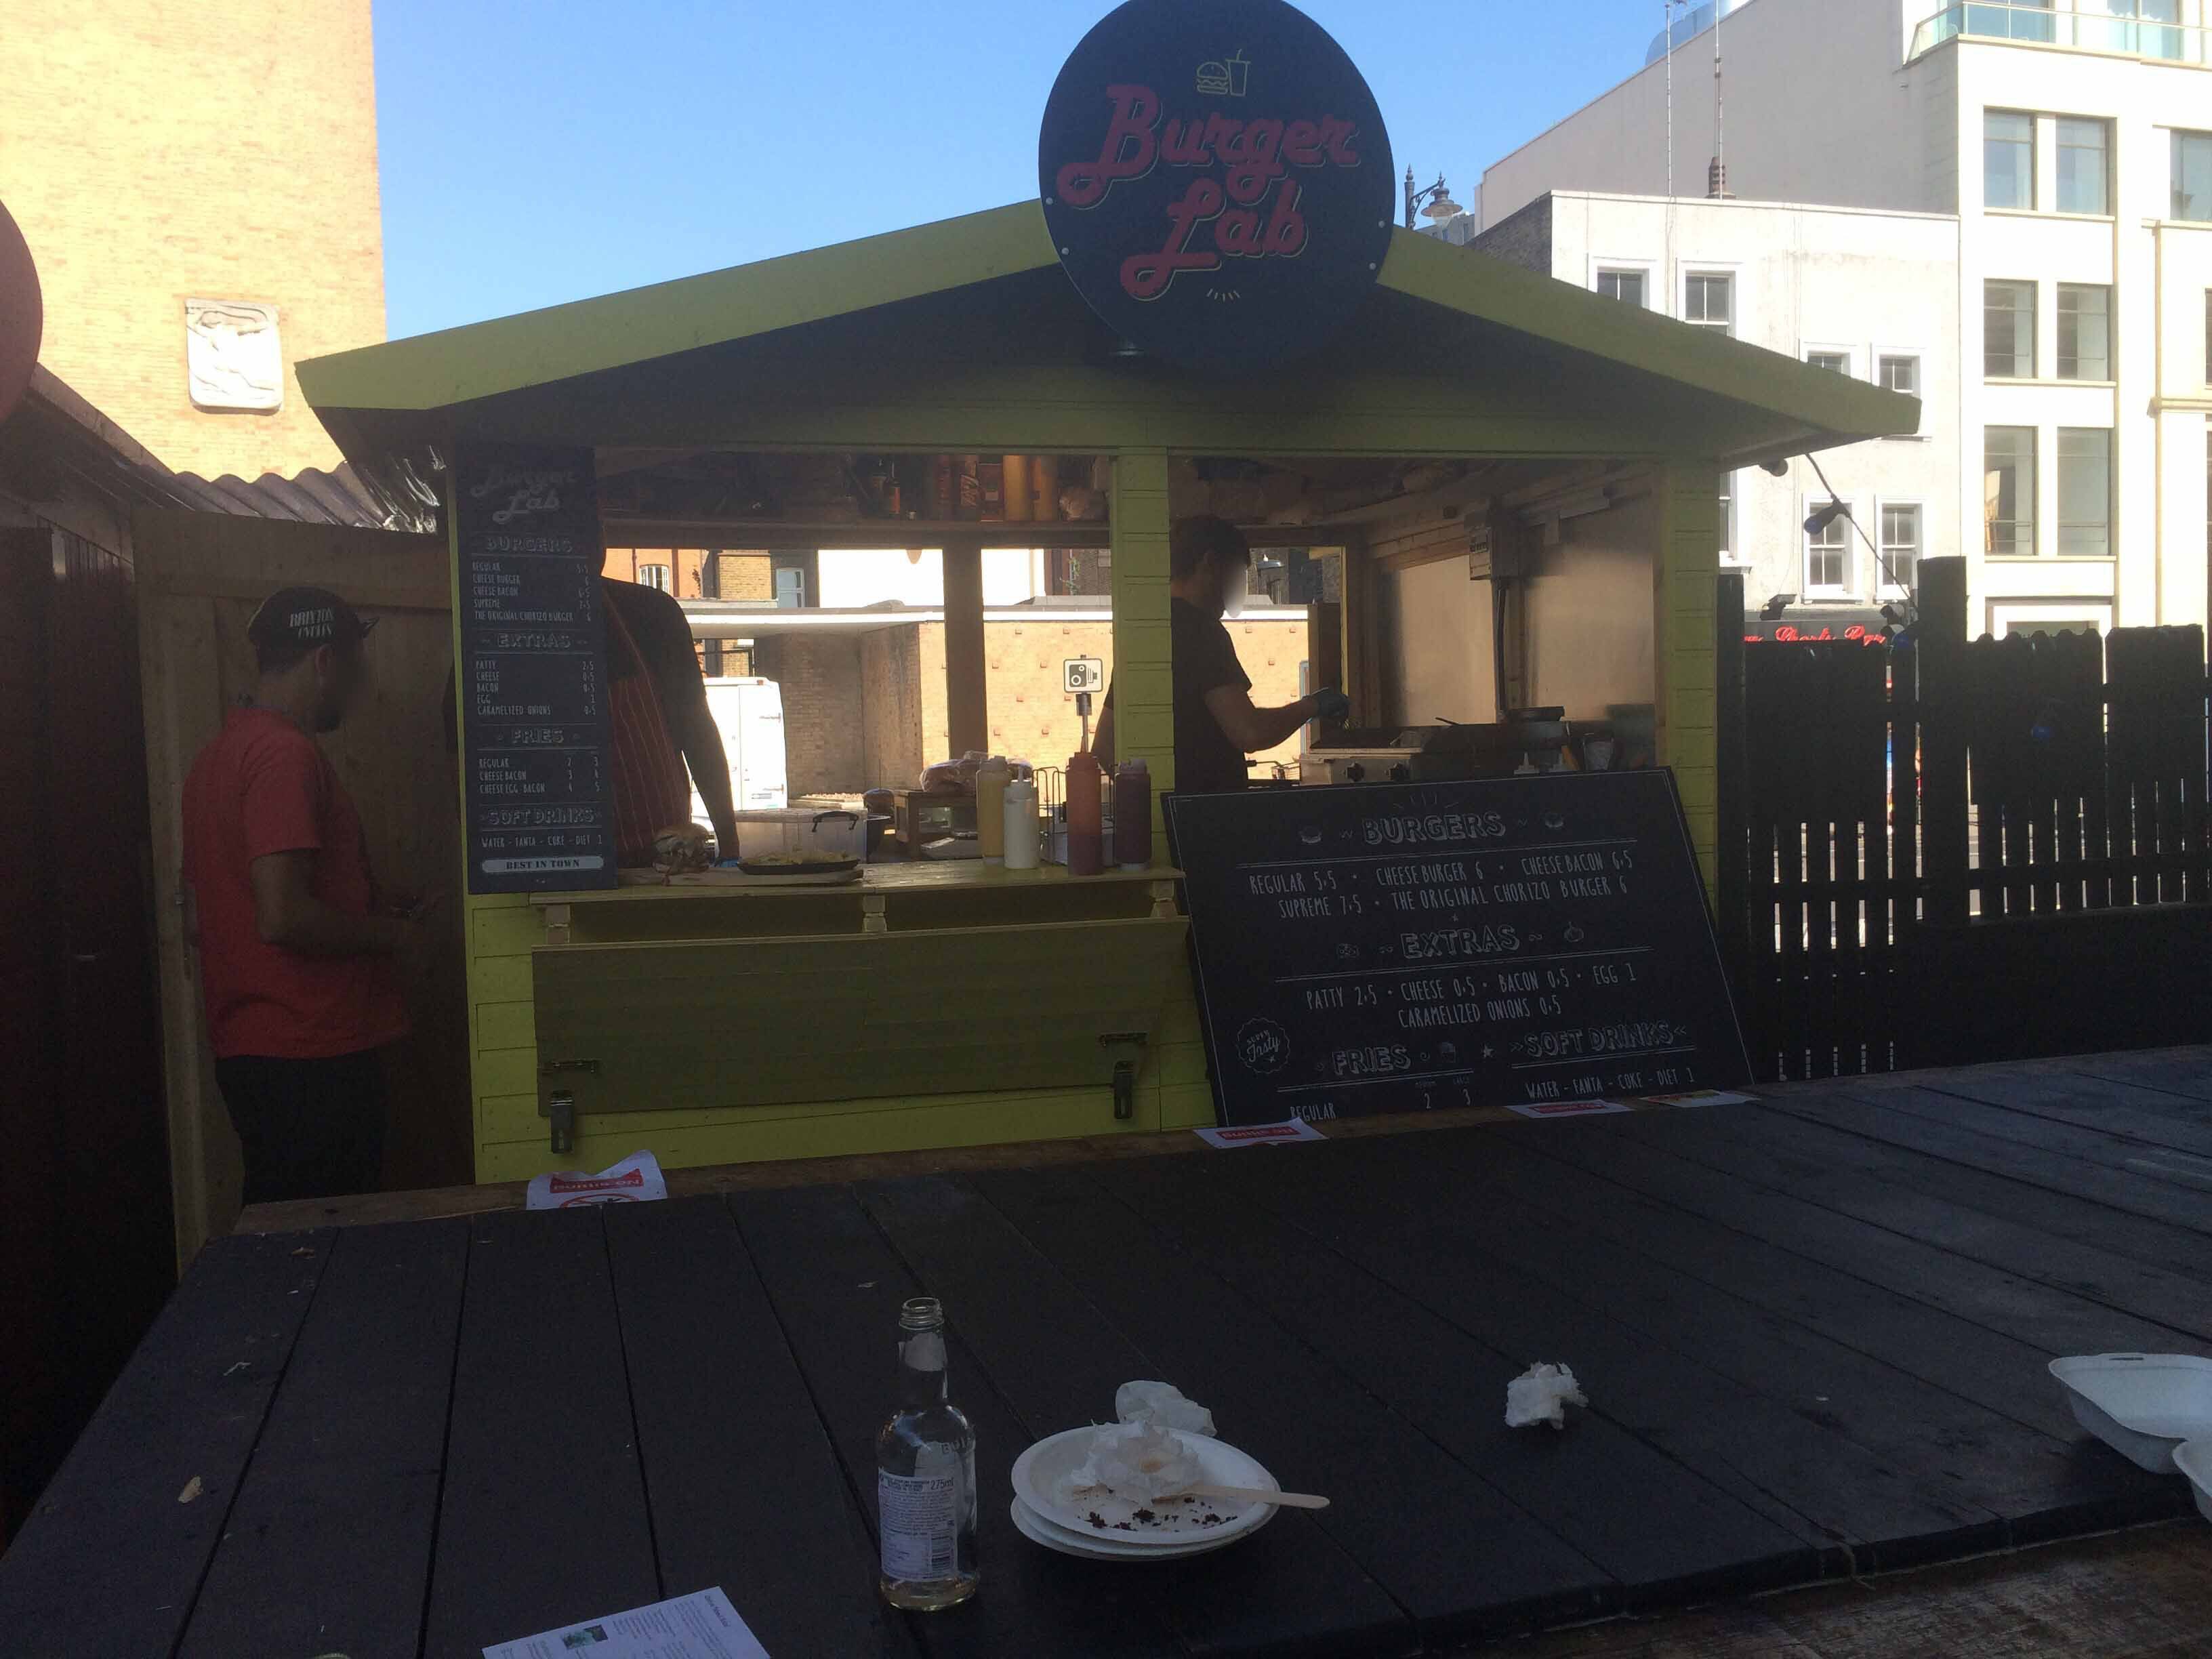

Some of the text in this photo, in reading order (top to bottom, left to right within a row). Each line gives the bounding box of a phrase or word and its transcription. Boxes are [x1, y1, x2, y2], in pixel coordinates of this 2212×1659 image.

[1057, 83, 1361, 210] Burger
[1121, 178, 1311, 301] Lab
[498, 633, 571, 649] EXTRAS
[476, 672, 499, 682] CHEESE
[477, 682, 499, 693] BACON
[477, 694, 491, 705] EGG
[478, 705, 524, 716] CARAMELIZED
[512, 727, 565, 743] FRIES
[478, 758, 510, 769] REGULAR
[479, 771, 504, 781] CHEESE
[505, 770, 527, 781] BACON
[1361, 811, 1507, 845] BURGERS
[481, 835, 505, 848] WATER
[506, 859, 580, 870] BEST IN TOWN
[1376, 861, 1484, 886] CHEESE BURGER 6
[1521, 855, 1561, 876] CHEESE
[1565, 851, 1605, 874] BACON
[1248, 872, 1307, 895] REGULAR
[1391, 876, 1628, 911] THE ORIGINAL CHORIZO BURGER 6
[1277, 896, 1332, 919] SUPREME
[1399, 923, 1521, 959] EXTRAS
[1497, 970, 1540, 993] BACON
[1592, 962, 1637, 985] EGG 1
[1306, 986, 1345, 1010] PATTY
[1399, 979, 1444, 1002] CHEESE
[1397, 1003, 1481, 1029] CARAMELIZED
[1486, 998, 1531, 1021] ONIONS
[1524, 1020, 1675, 1058] SOFT DRINKS
[1331, 1044, 1412, 1076] FRIES
[1525, 1080, 1560, 1101] WATER
[1572, 1075, 1605, 1095] FANTA
[1617, 1071, 1643, 1090] COKE
[1656, 1067, 1679, 1086] DIET
[1290, 1101, 1337, 1123] REGULAR
